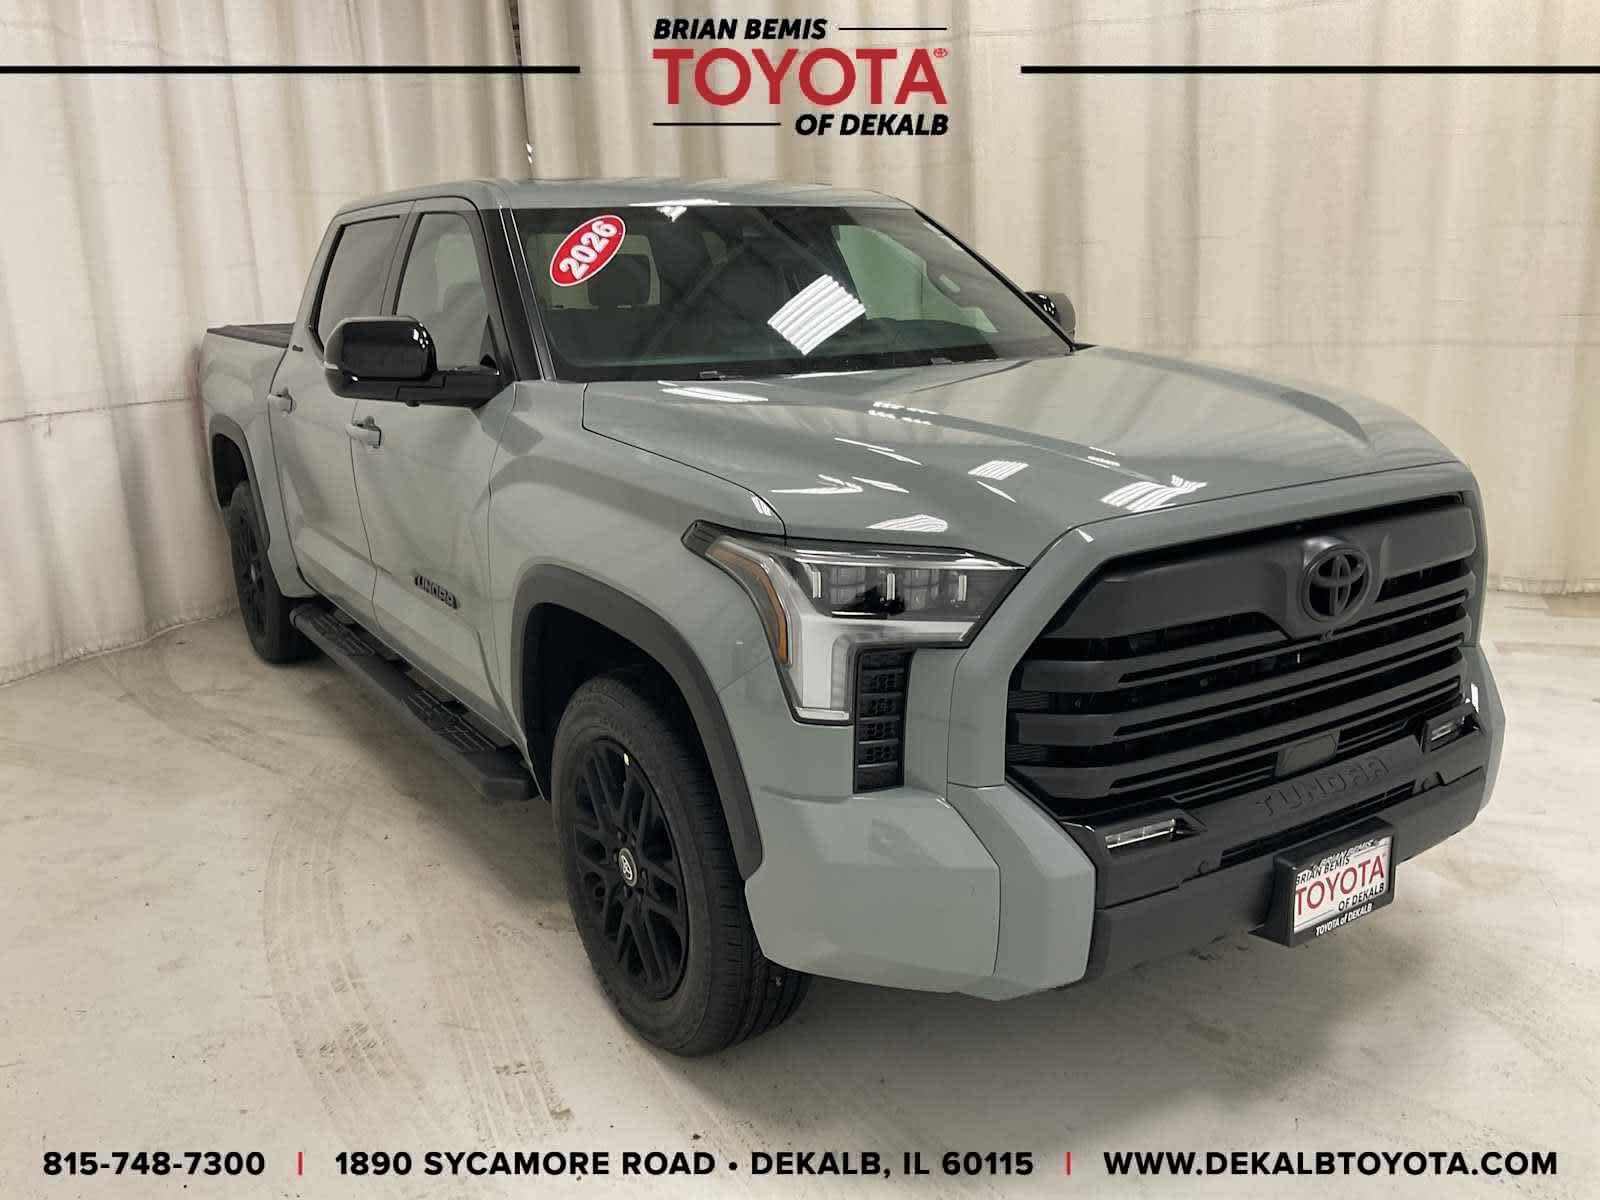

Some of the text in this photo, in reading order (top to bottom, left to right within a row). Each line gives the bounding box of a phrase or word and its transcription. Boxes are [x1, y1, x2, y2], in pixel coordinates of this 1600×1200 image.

[559, 220, 618, 280] 2026
[1295, 855, 1385, 916] TOYOTA
[1338, 882, 1385, 912] OF DEKALB
[1315, 918, 1340, 936] TOYOTA
[1347, 903, 1373, 922] DEKALB
